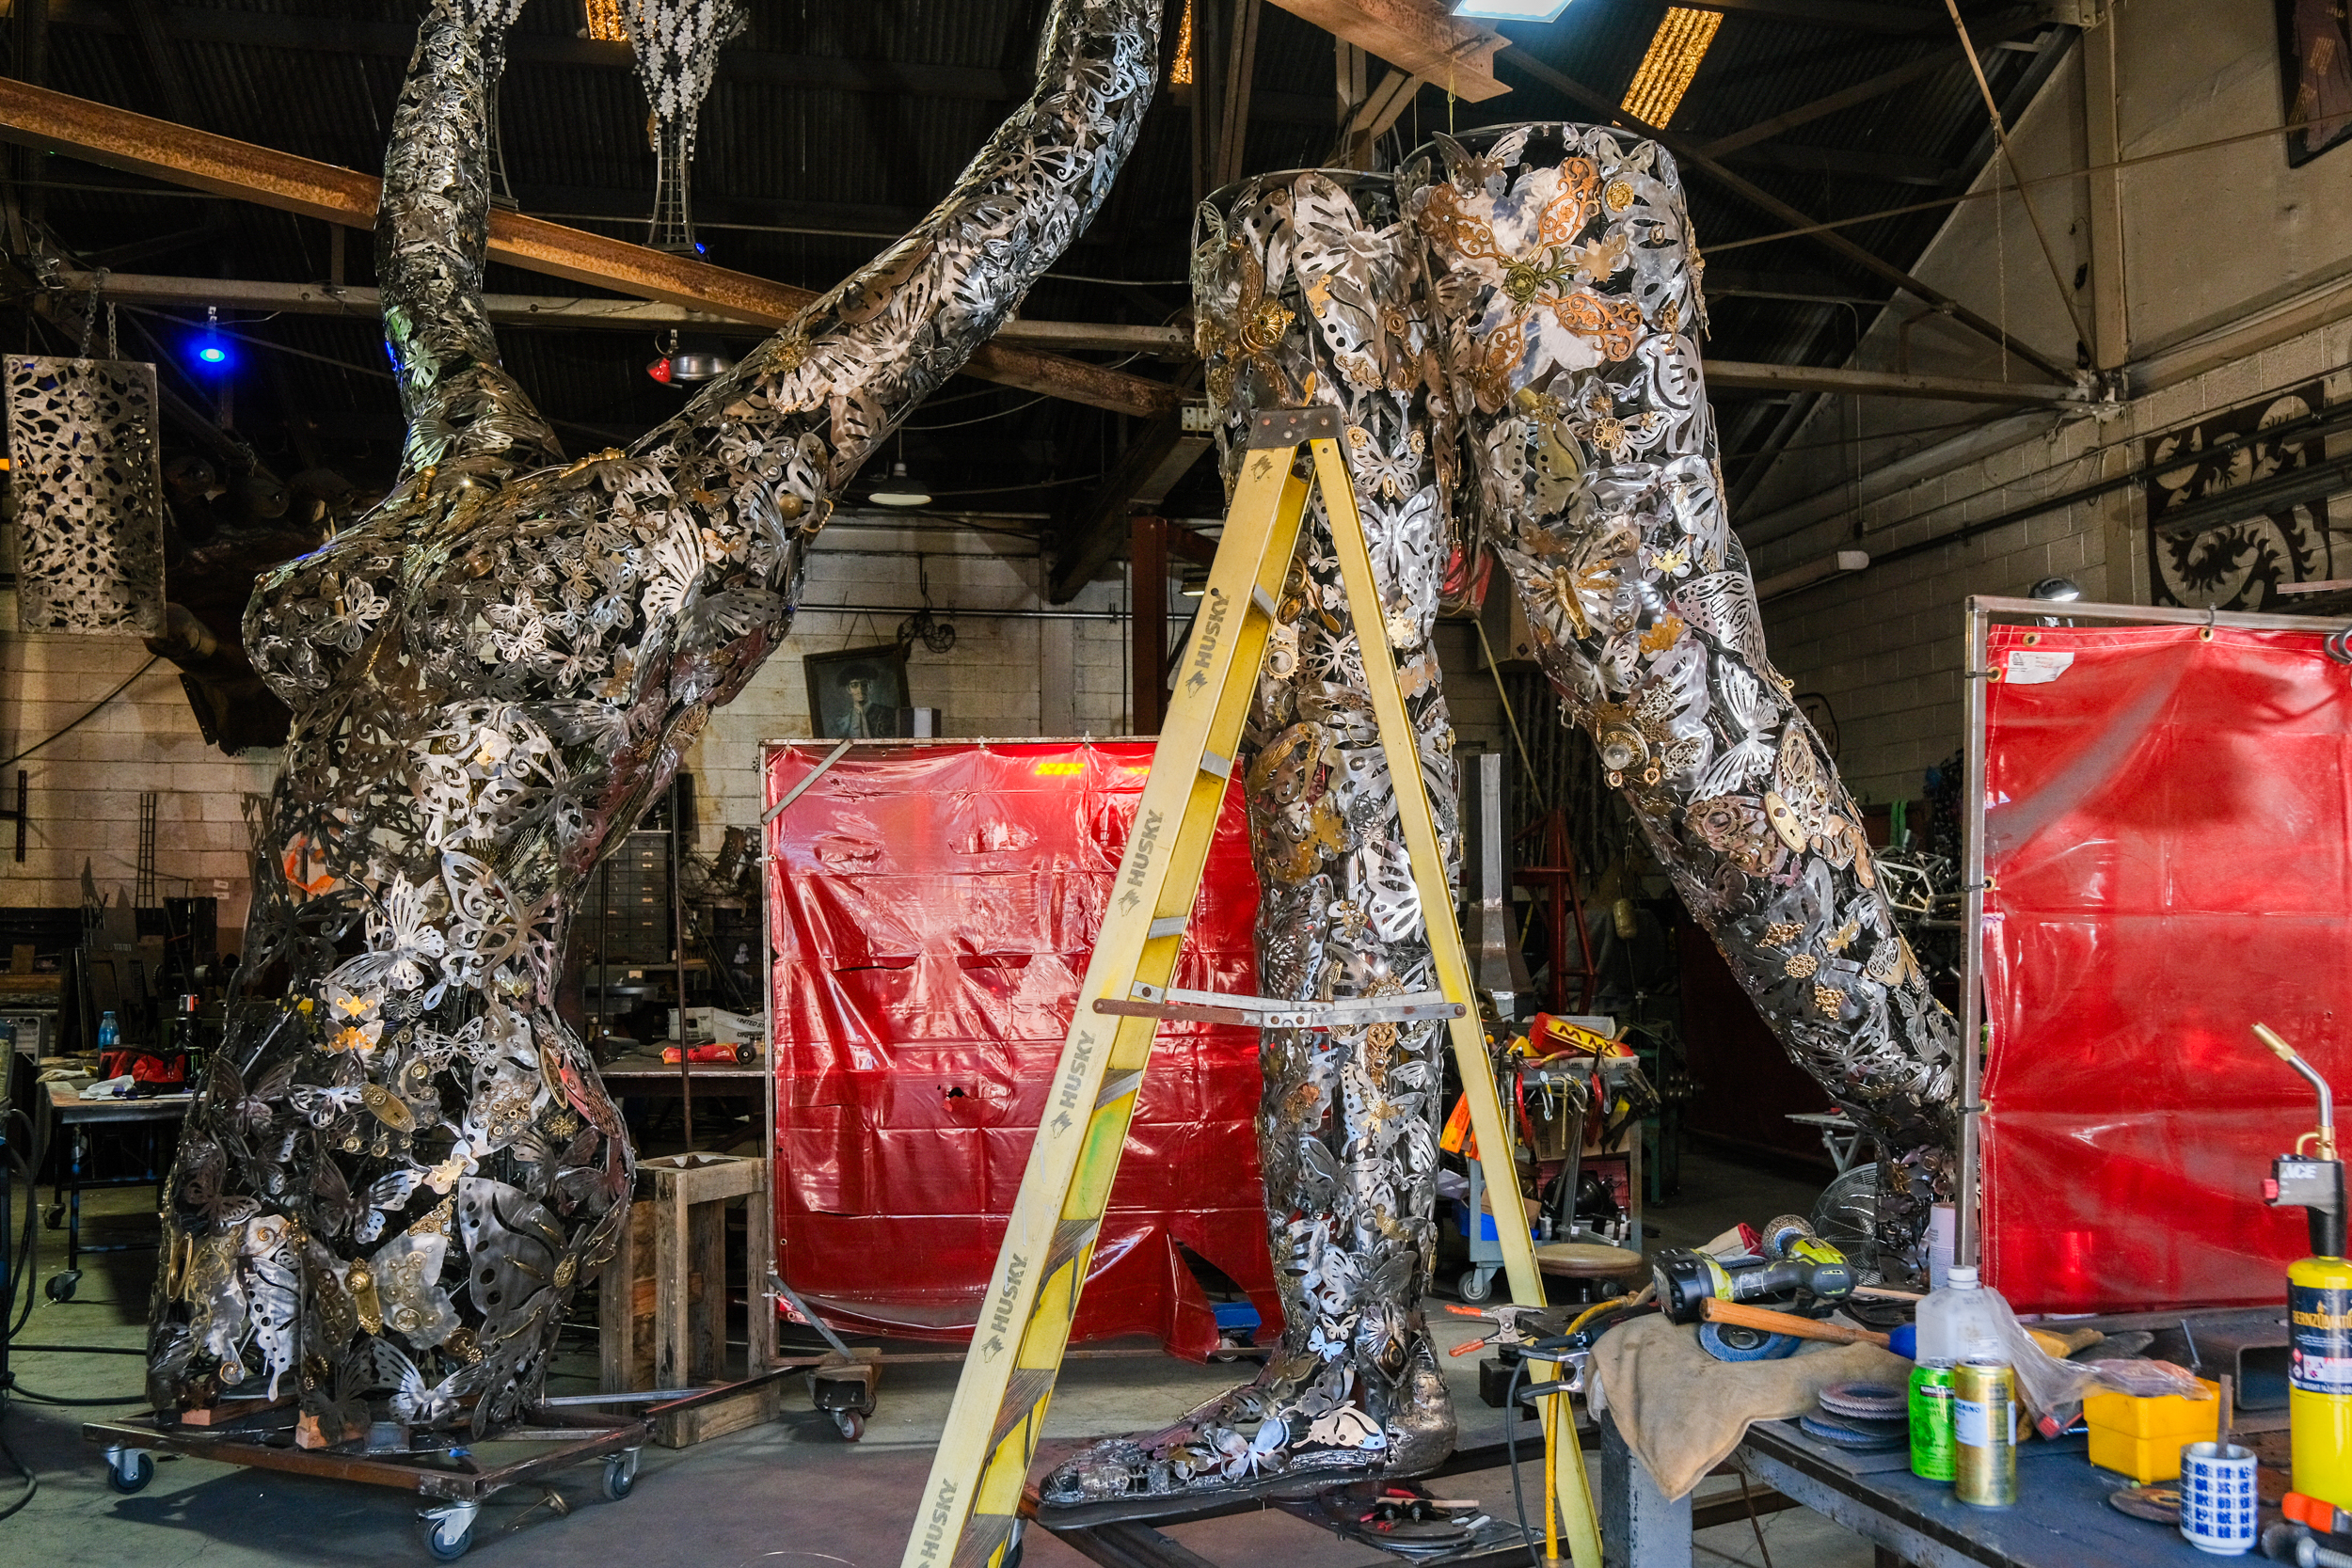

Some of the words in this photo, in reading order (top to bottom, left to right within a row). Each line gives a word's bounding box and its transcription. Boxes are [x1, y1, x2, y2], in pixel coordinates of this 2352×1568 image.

[1194, 593, 1230, 669] HUSKY
[1126, 809, 1163, 888] HUSKY
[1059, 1030, 1095, 1110] HUSKY
[2280, 1164, 2318, 1180] ACE
[991, 1253, 1027, 1334] HUSKY
[920, 1478, 957, 1560] HUSKY
